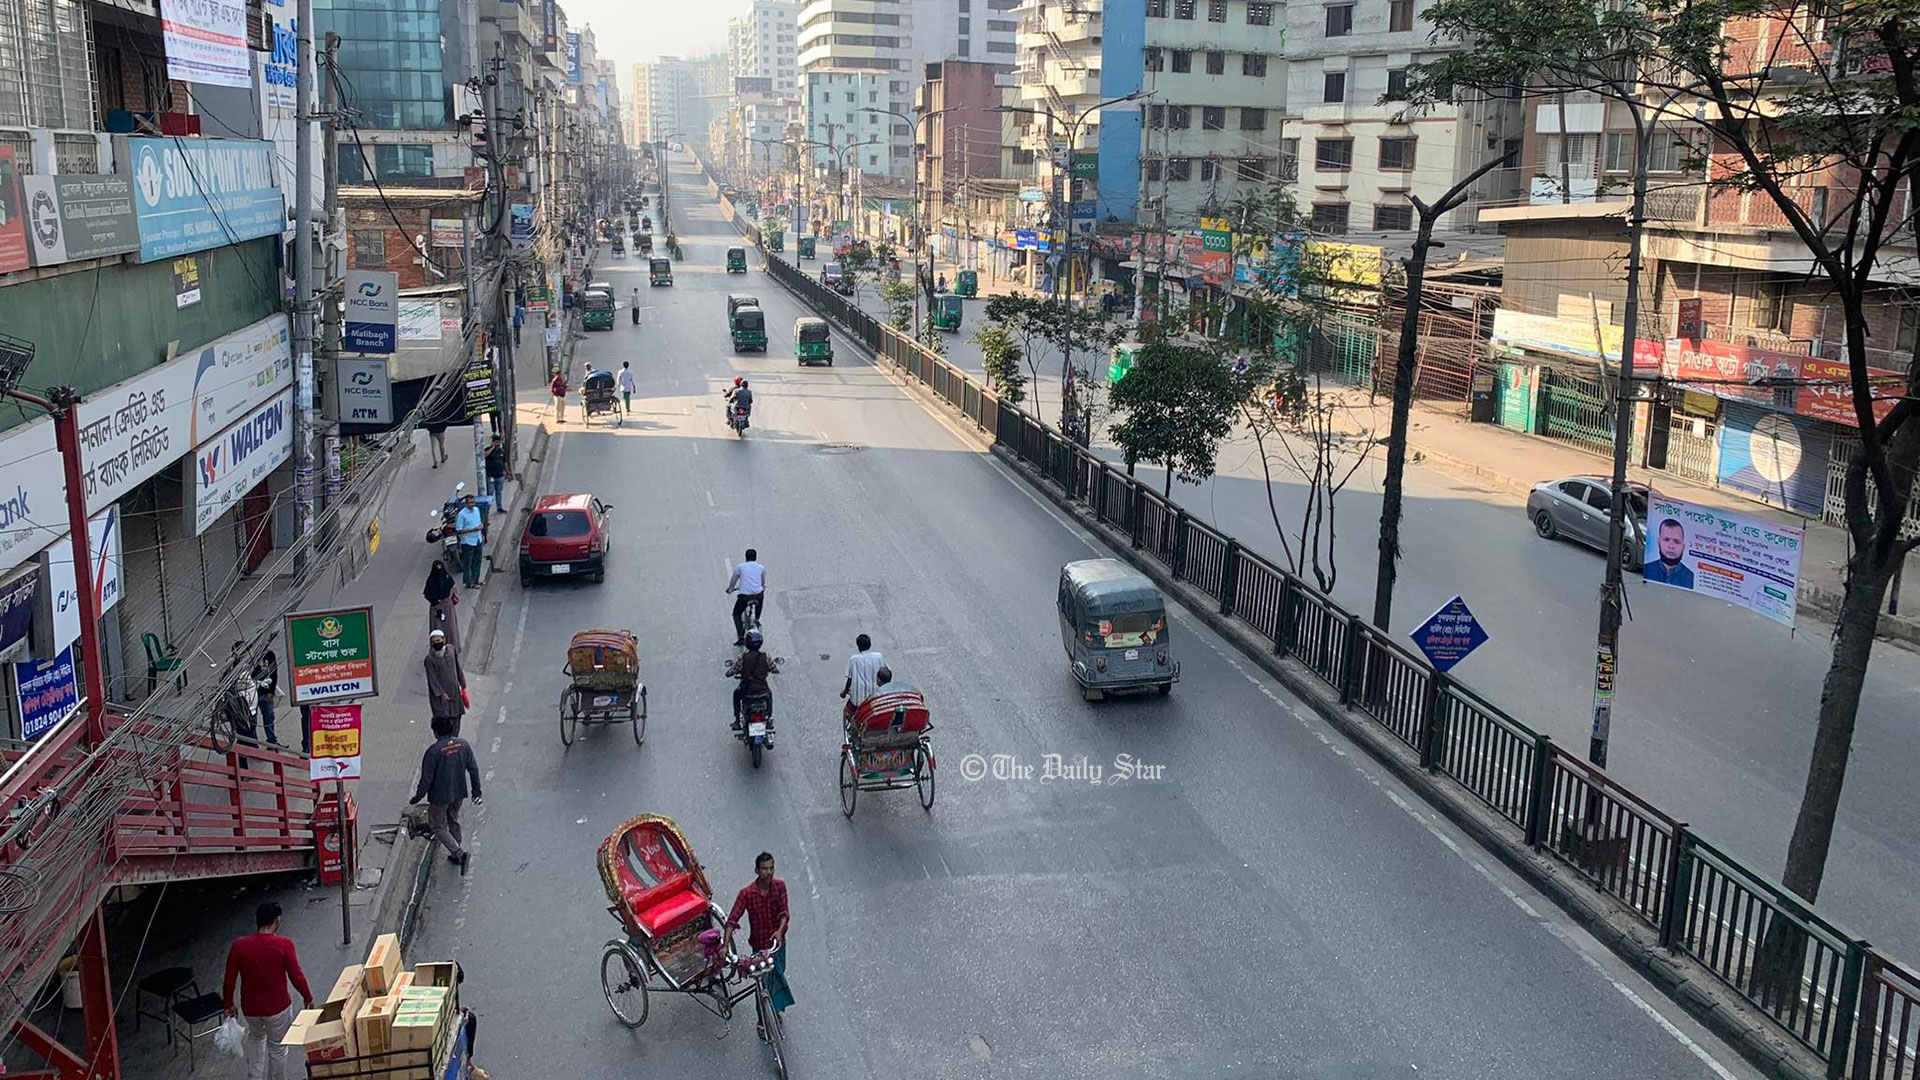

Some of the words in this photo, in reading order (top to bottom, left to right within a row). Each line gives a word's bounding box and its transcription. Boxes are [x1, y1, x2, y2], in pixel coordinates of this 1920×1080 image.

[369, 300, 389, 308] Bank
[351, 329, 389, 340] Malibagh
[356, 339, 384, 347] Branch
[114, 391, 148, 436] ক্রেডিট
[352, 408, 377, 419] ATM
[231, 400, 283, 467] WALTON
[98, 449, 129, 488] ব্যাংক
[130, 425, 169, 471] লিমিটেড
[0, 484, 31, 531] ank
[1653, 502, 1681, 518] সাউথ
[1684, 508, 1715, 526] পয়েন্ট
[1717, 516, 1737, 533] স্কুল
[1763, 530, 1799, 550] কলেজ
[103, 577, 117, 602] ATM
[321, 639, 340, 648] বাস
[305, 649, 338, 661] স্টপেজ
[310, 681, 360, 696] WALTON
[24, 714, 47, 735] 01824
[47, 708, 63, 726] 904
